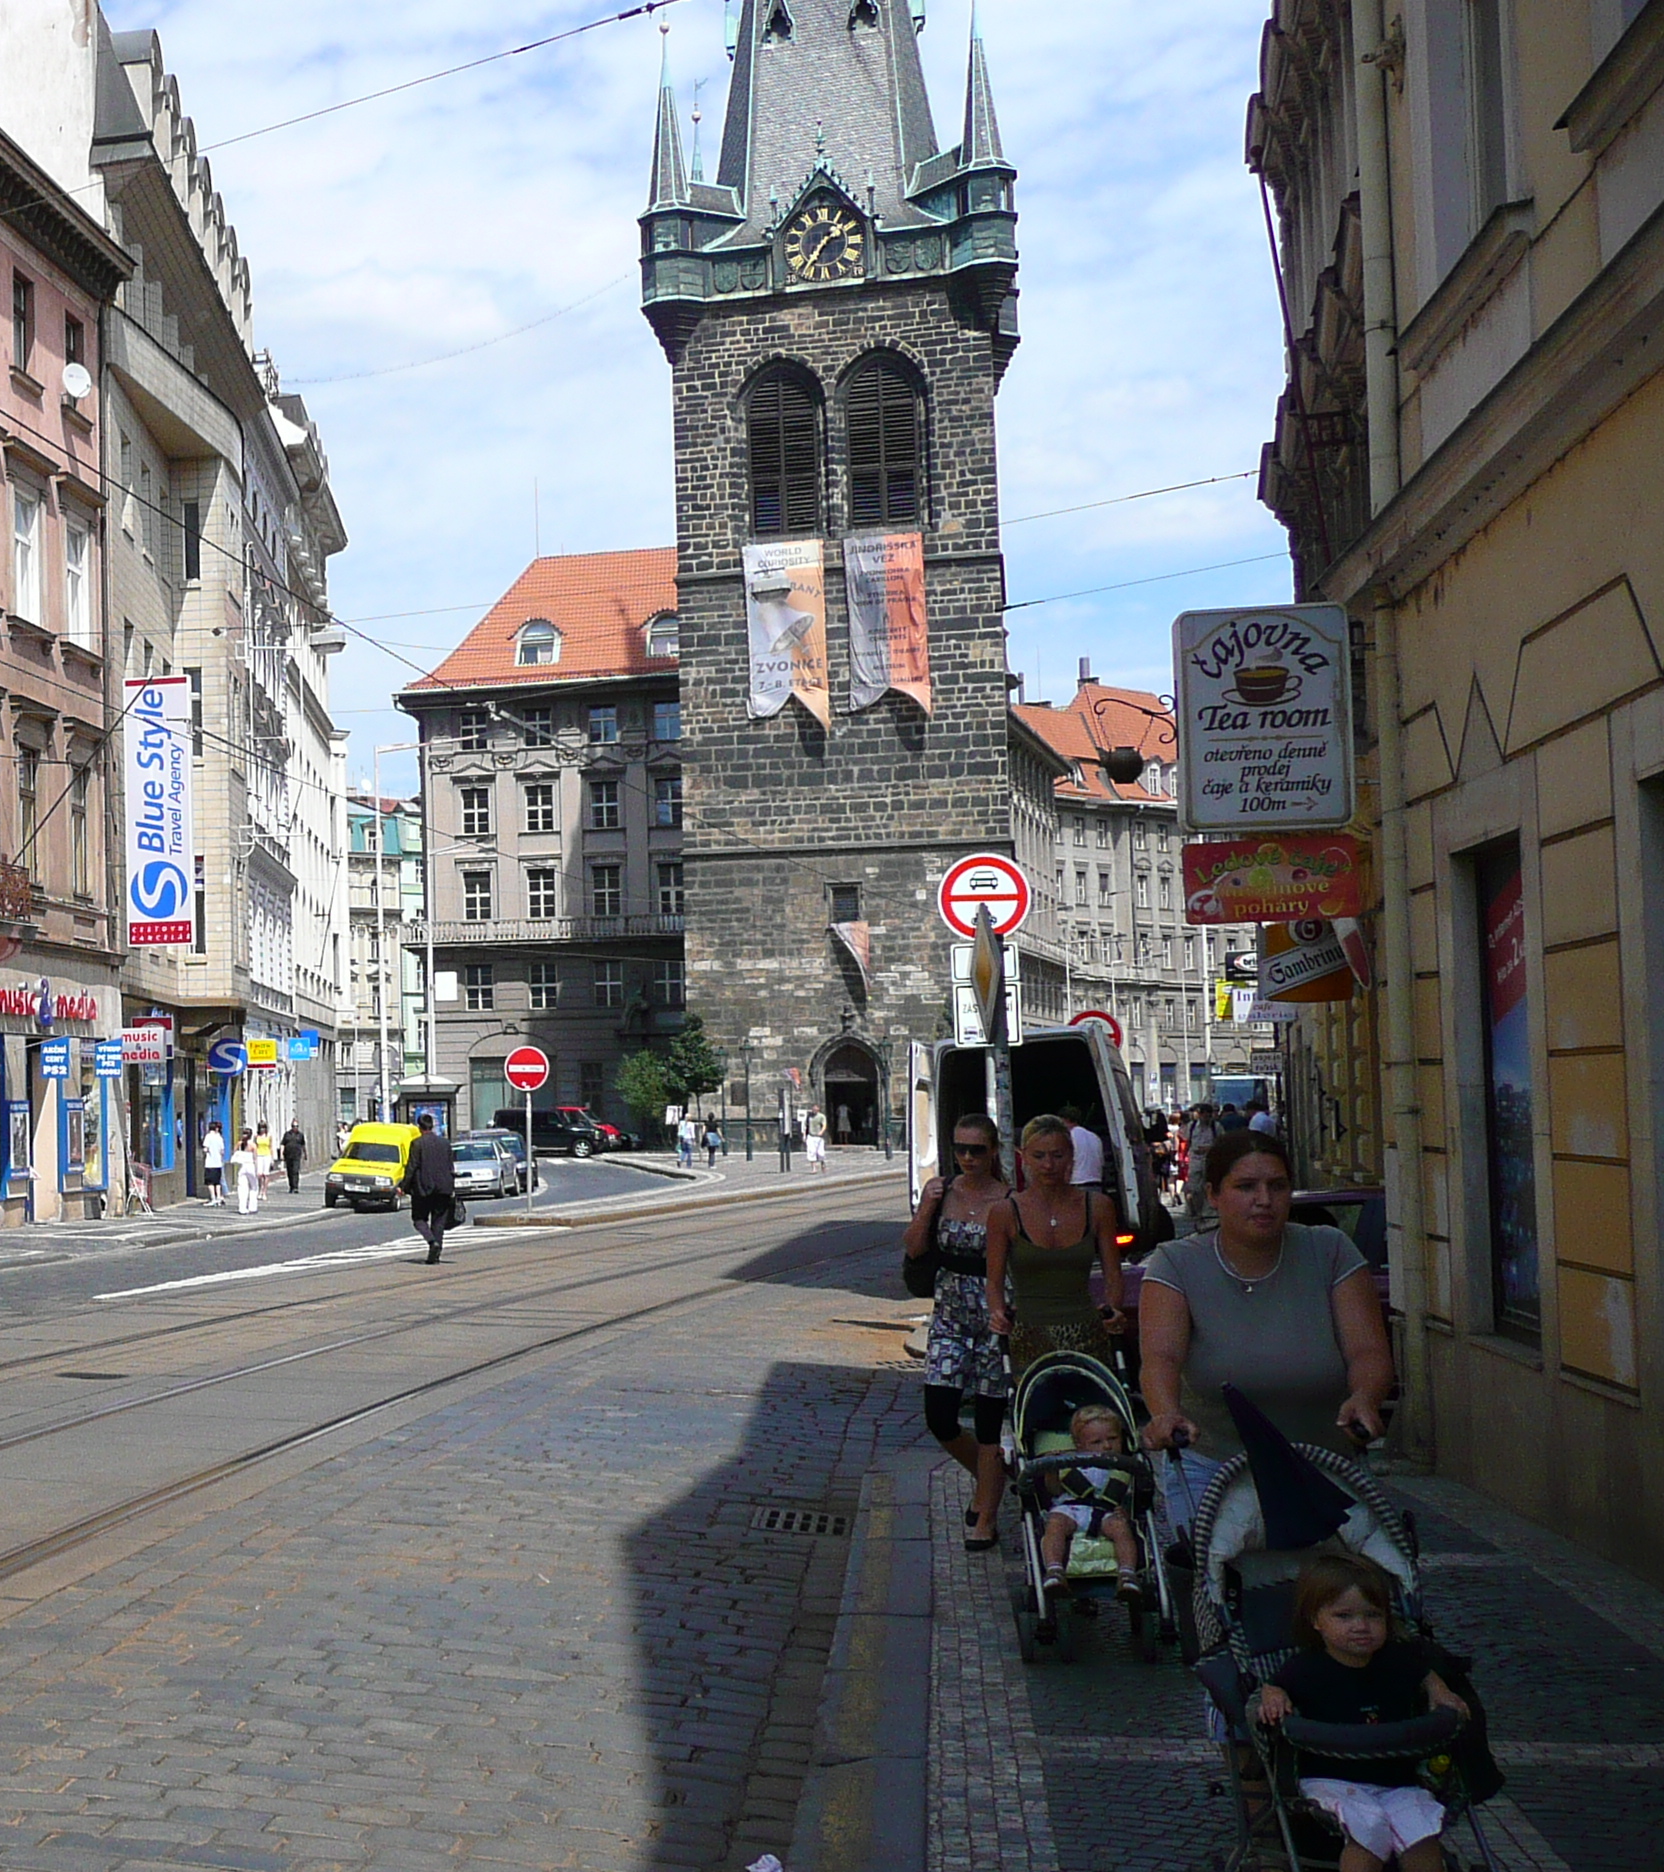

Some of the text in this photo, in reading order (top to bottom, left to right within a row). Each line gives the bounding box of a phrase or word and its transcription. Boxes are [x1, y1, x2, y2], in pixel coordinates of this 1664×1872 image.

[757, 556, 810, 568] CURIOSITY
[764, 547, 802, 558] WORLD
[756, 658, 823, 674] ZVONICE
[1198, 704, 1332, 732] Tea room
[1203, 741, 1329, 763] otevřeno denně
[134, 689, 171, 854] Blue Style
[1240, 759, 1291, 783] prodej
[1202, 773, 1332, 800] čaje a keramiky
[167, 744, 185, 856] Travel Agency
[1239, 796, 1287, 813] 100m
[1194, 848, 1336, 884] Ledové čaje
[1234, 898, 1309, 918] poháry
[1269, 945, 1346, 985] Gambrinu
[56, 988, 98, 1021] media
[122, 1030, 158, 1042] music
[121, 1049, 160, 1061] media
[43, 1065, 67, 1075] PS2
